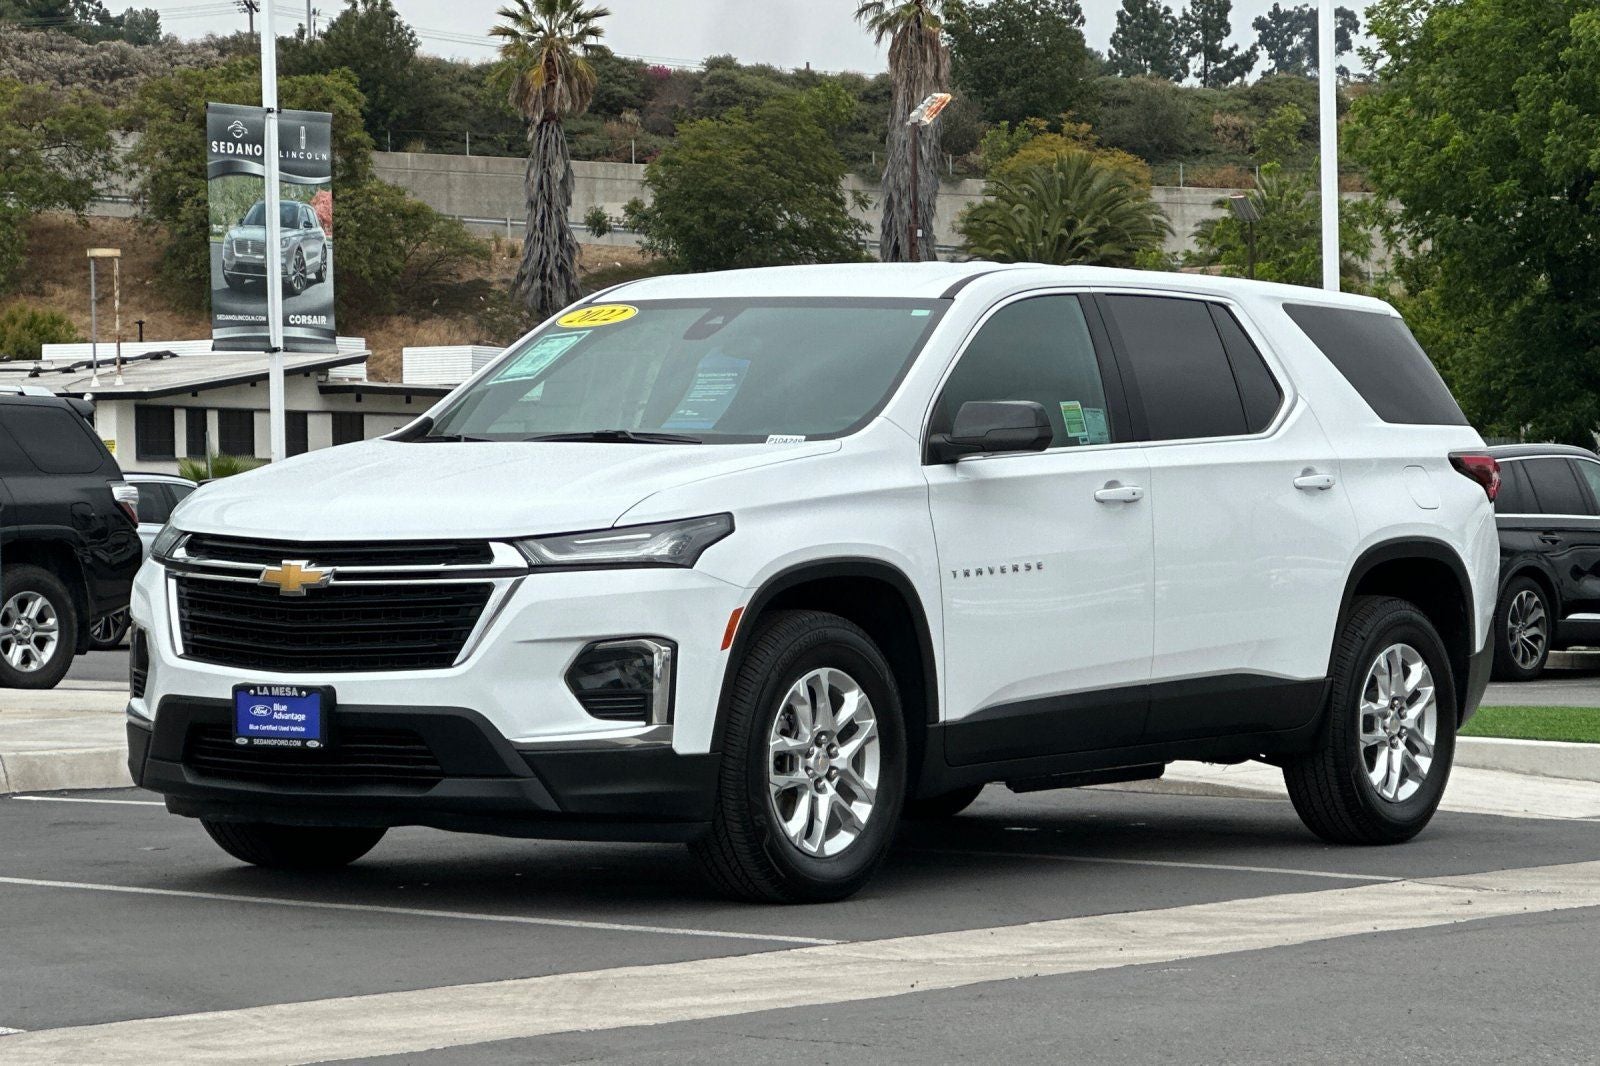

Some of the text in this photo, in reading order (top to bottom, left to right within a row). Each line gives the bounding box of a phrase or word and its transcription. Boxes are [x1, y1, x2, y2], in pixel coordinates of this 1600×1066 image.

[211, 140, 327, 160] SEDANO LINCOLN
[288, 314, 327, 325] CORSAIR
[951, 561, 1043, 579] TRAVERSE
[257, 686, 299, 697] LA MESA
[253, 705, 269, 715] Ford
[273, 703, 288, 712] Blue
[273, 712, 306, 722] Advantage
